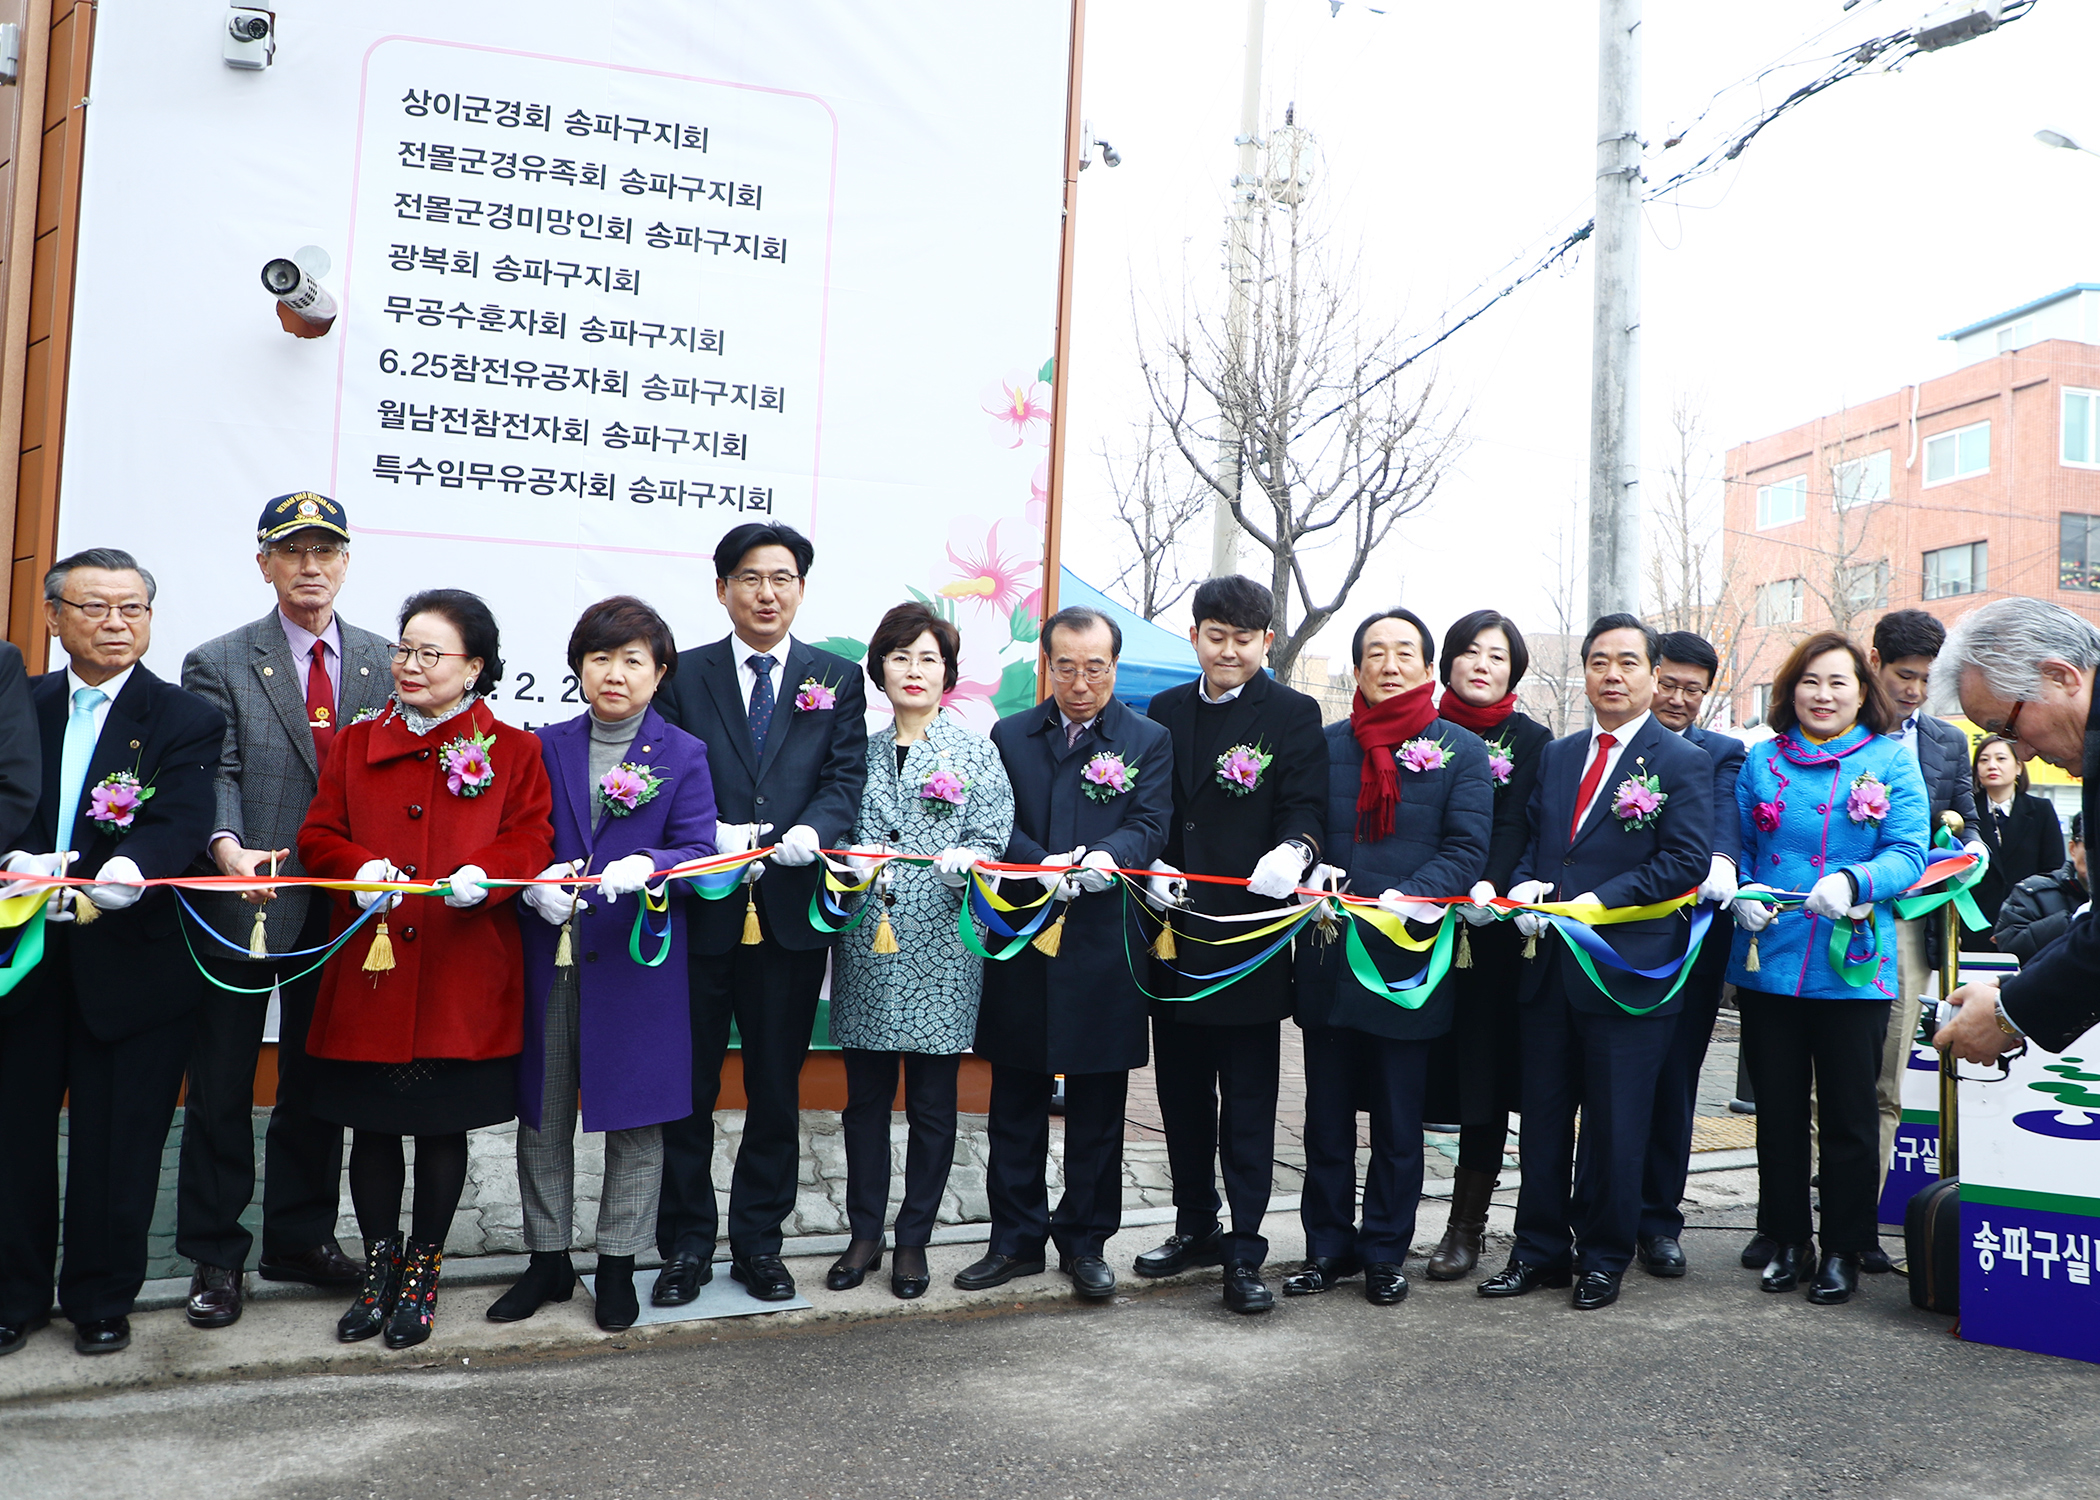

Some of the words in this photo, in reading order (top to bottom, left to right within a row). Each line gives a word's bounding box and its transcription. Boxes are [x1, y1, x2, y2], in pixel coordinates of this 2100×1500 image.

[402, 89, 550, 131] 상이군경회
[565, 109, 708, 153] 송파구지회
[398, 142, 606, 190] 전몰군경유족회
[620, 168, 761, 210] 송파구지회
[394, 193, 632, 244] 전몰군경미망인회
[646, 222, 786, 263] 송파구지회
[389, 244, 478, 278] 광복회
[493, 255, 639, 295] 송파구지회
[384, 296, 566, 339] 무공수훈자회
[580, 316, 723, 355] 송파구지회
[380, 349, 628, 397] 6.25참전유공자회
[642, 374, 784, 413] 송파구지회
[378, 400, 588, 446] 월남전참전자회
[603, 422, 746, 460] 송파구지회
[373, 455, 615, 500] 특수임무유공자회
[629, 476, 772, 514] 송파구지회
